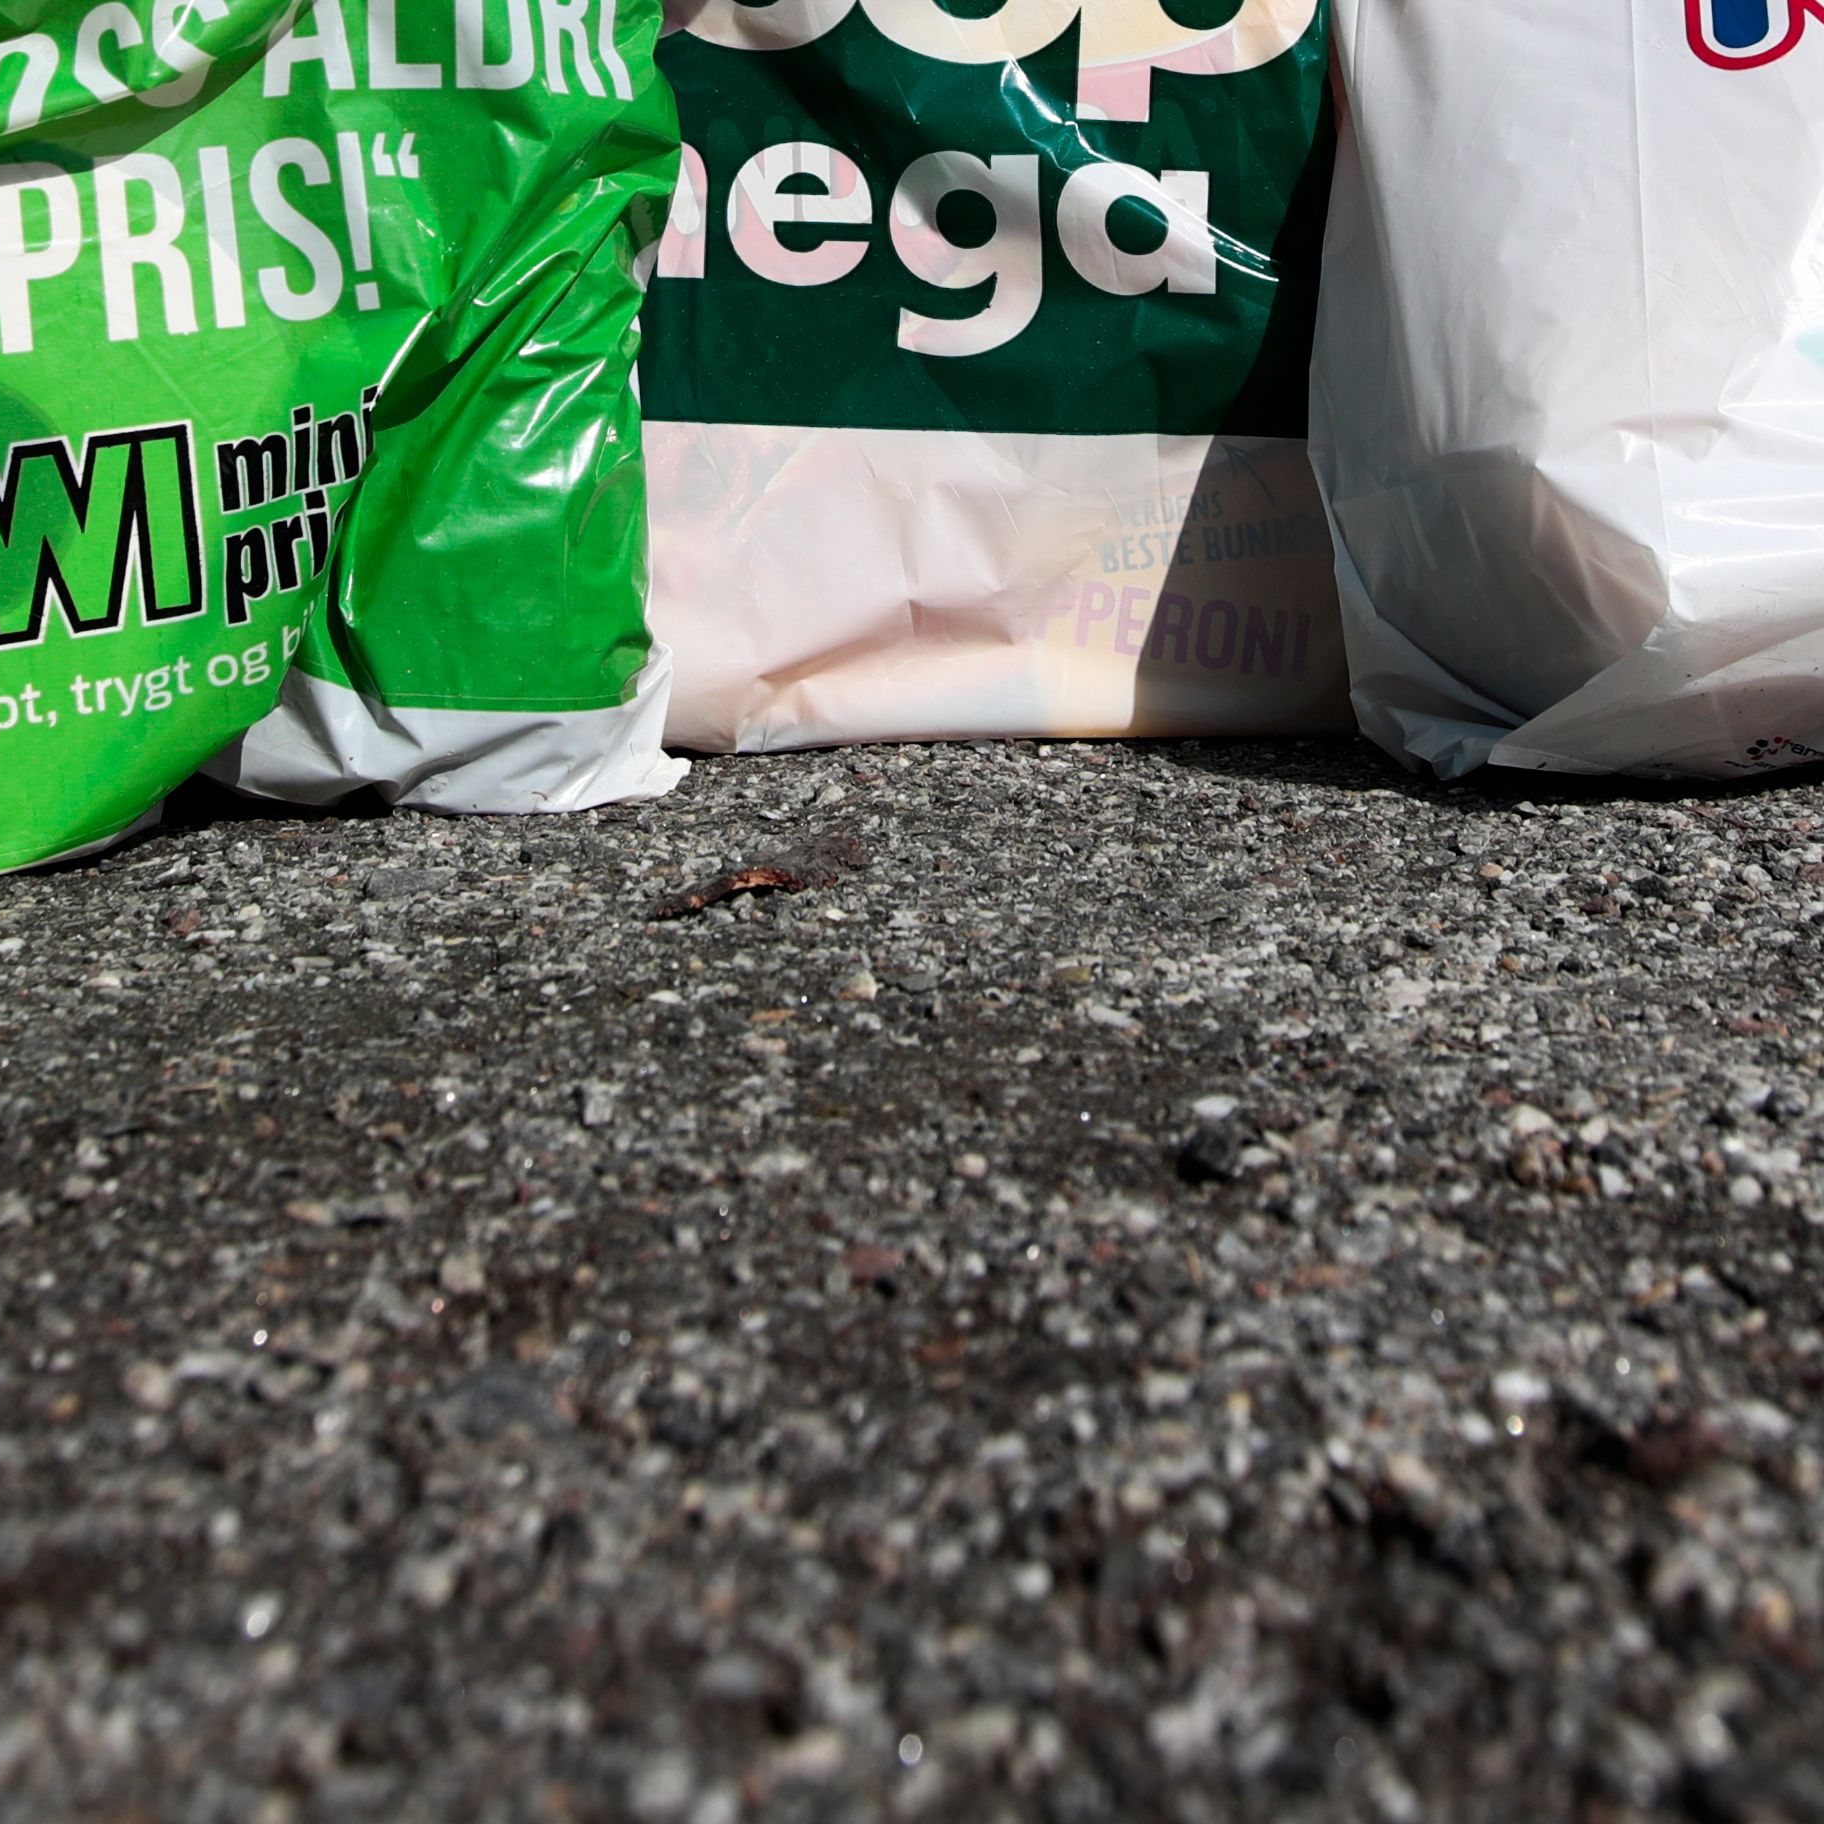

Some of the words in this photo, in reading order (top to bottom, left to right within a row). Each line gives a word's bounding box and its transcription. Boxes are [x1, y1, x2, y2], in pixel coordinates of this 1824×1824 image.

[214, 384, 381, 516] mini
[223, 490, 348, 628] pri
[1100, 525, 1194, 574] BESTE
[70, 653, 193, 718] trygt
[206, 641, 272, 688] og
